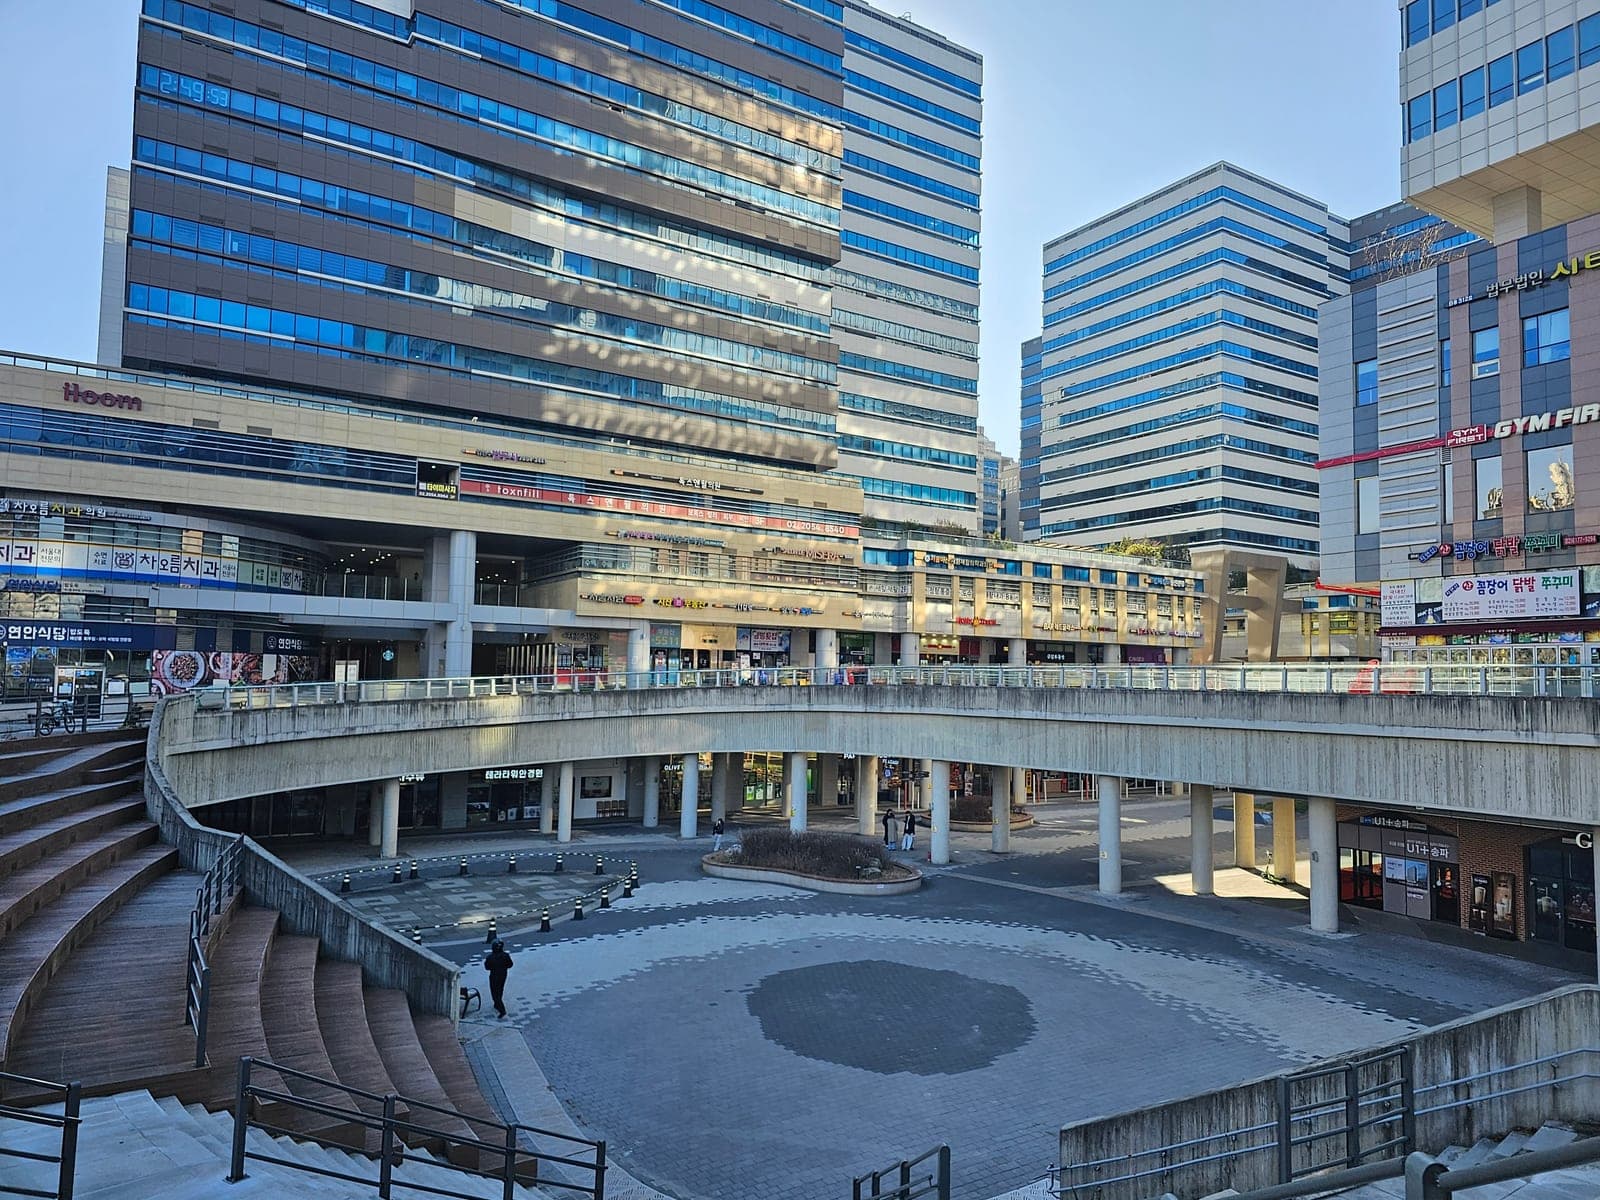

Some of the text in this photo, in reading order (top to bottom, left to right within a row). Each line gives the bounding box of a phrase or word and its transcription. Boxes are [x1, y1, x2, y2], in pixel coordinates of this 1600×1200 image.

[160, 72, 229, 108] 2:49:53
[1486, 268, 1543, 299] 법무법인
[1452, 427, 1479, 438] GYM
[1494, 413, 1551, 439] GYM
[1447, 433, 1485, 446] FIRST
[497, 487, 540, 499] toxnfill
[1454, 541, 1490, 561] 꼼장어
[1492, 535, 1520, 559] 닭발
[1524, 533, 1561, 553] 쭈꾸미
[1476, 580, 1508, 595] 꼼장어
[1512, 576, 1536, 593] 닭발
[1541, 575, 1573, 590] 쭈꾸미
[8, 625, 66, 641] 연안식당
